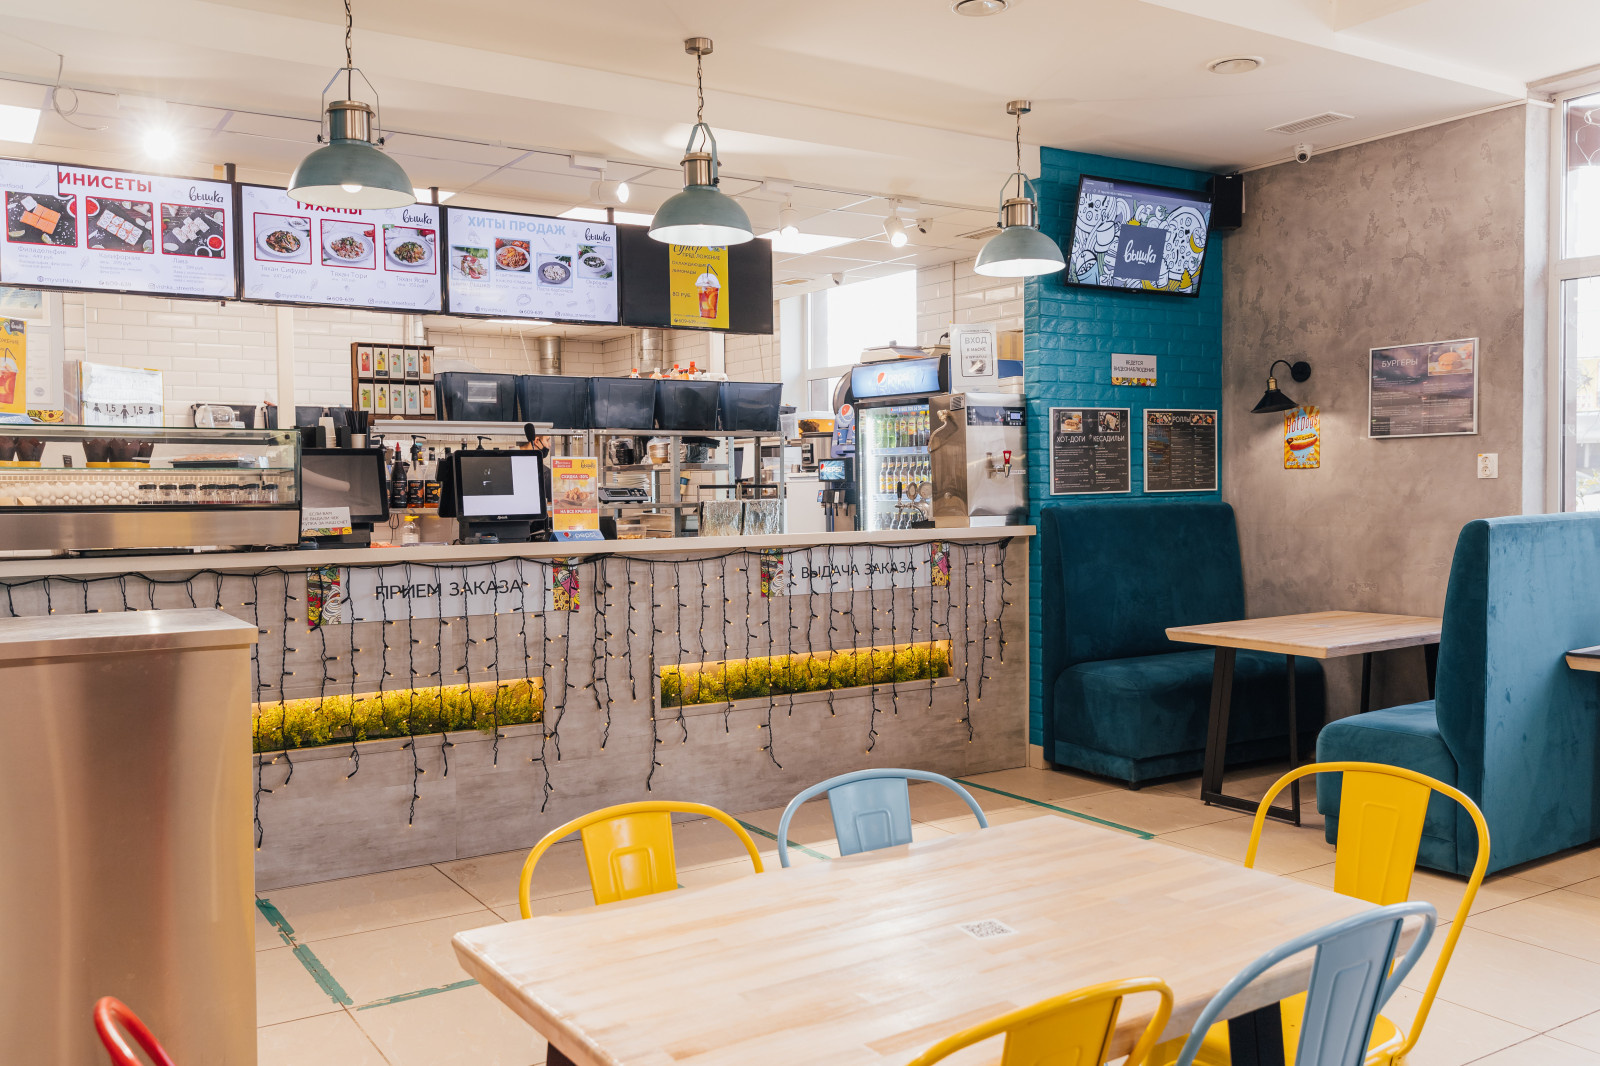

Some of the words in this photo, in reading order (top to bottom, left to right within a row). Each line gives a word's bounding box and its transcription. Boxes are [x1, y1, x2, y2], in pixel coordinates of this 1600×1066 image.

[59, 172, 151, 192] ИНИСЕТЫ
[189, 186, 223, 204] вышка
[403, 209, 432, 225] вышка
[468, 216, 505, 230] ХИТЫ
[510, 220, 566, 235] ПРОДАЖ
[1124, 239, 1157, 264] вышка
[964, 336, 988, 345] ВХОД
[1381, 358, 1418, 368] БУРГЕРЫ
[1172, 415, 1191, 423] РОЛЛЫ
[1093, 435, 1125, 443] КЕСАДИЛЬИ
[801, 564, 860, 581] ВЫДАЧА
[864, 562, 914, 576] ЗАКАЗА
[375, 584, 441, 601] ПРИЕМ
[449, 580, 522, 597] ЗАКАЗА
